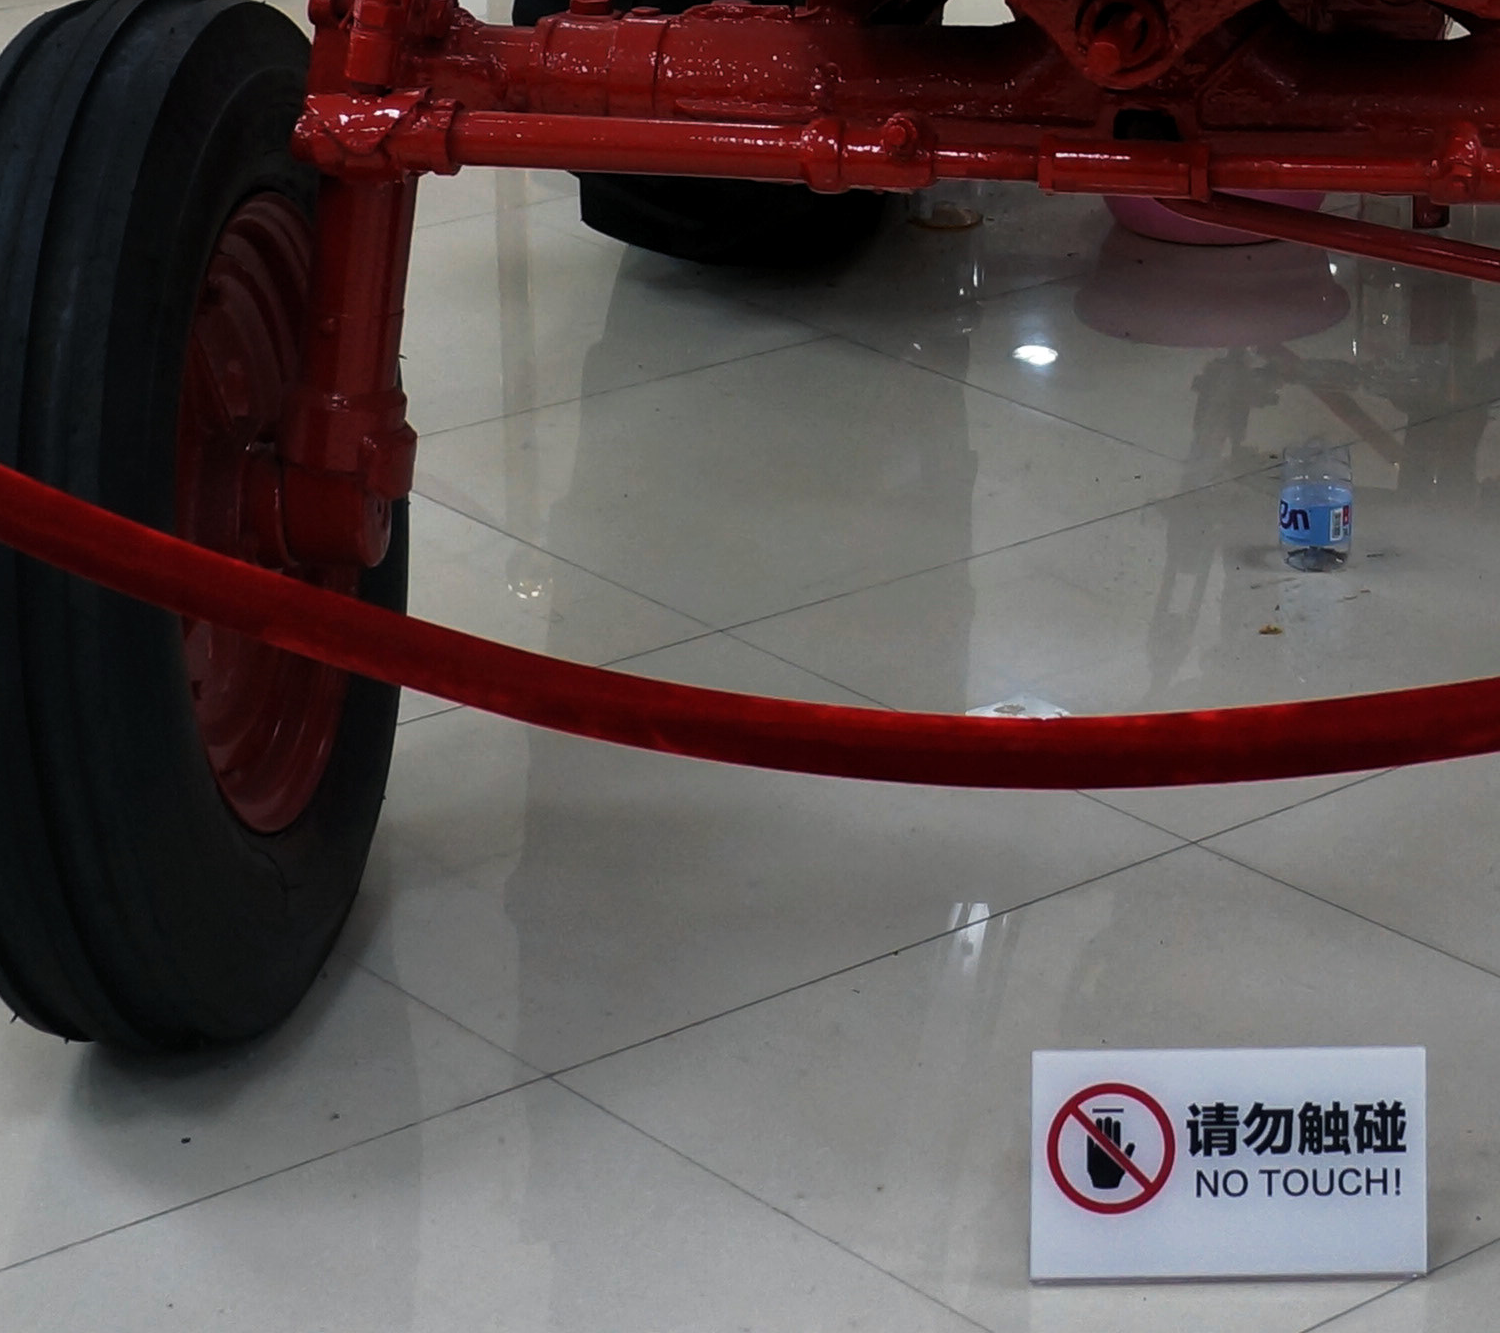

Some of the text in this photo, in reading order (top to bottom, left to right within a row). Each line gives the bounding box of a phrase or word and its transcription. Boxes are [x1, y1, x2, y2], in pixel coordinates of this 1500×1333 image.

[1186, 1100, 1407, 1157] 请勿触碰
[1195, 1167, 1402, 1198] NO TOUCH!
